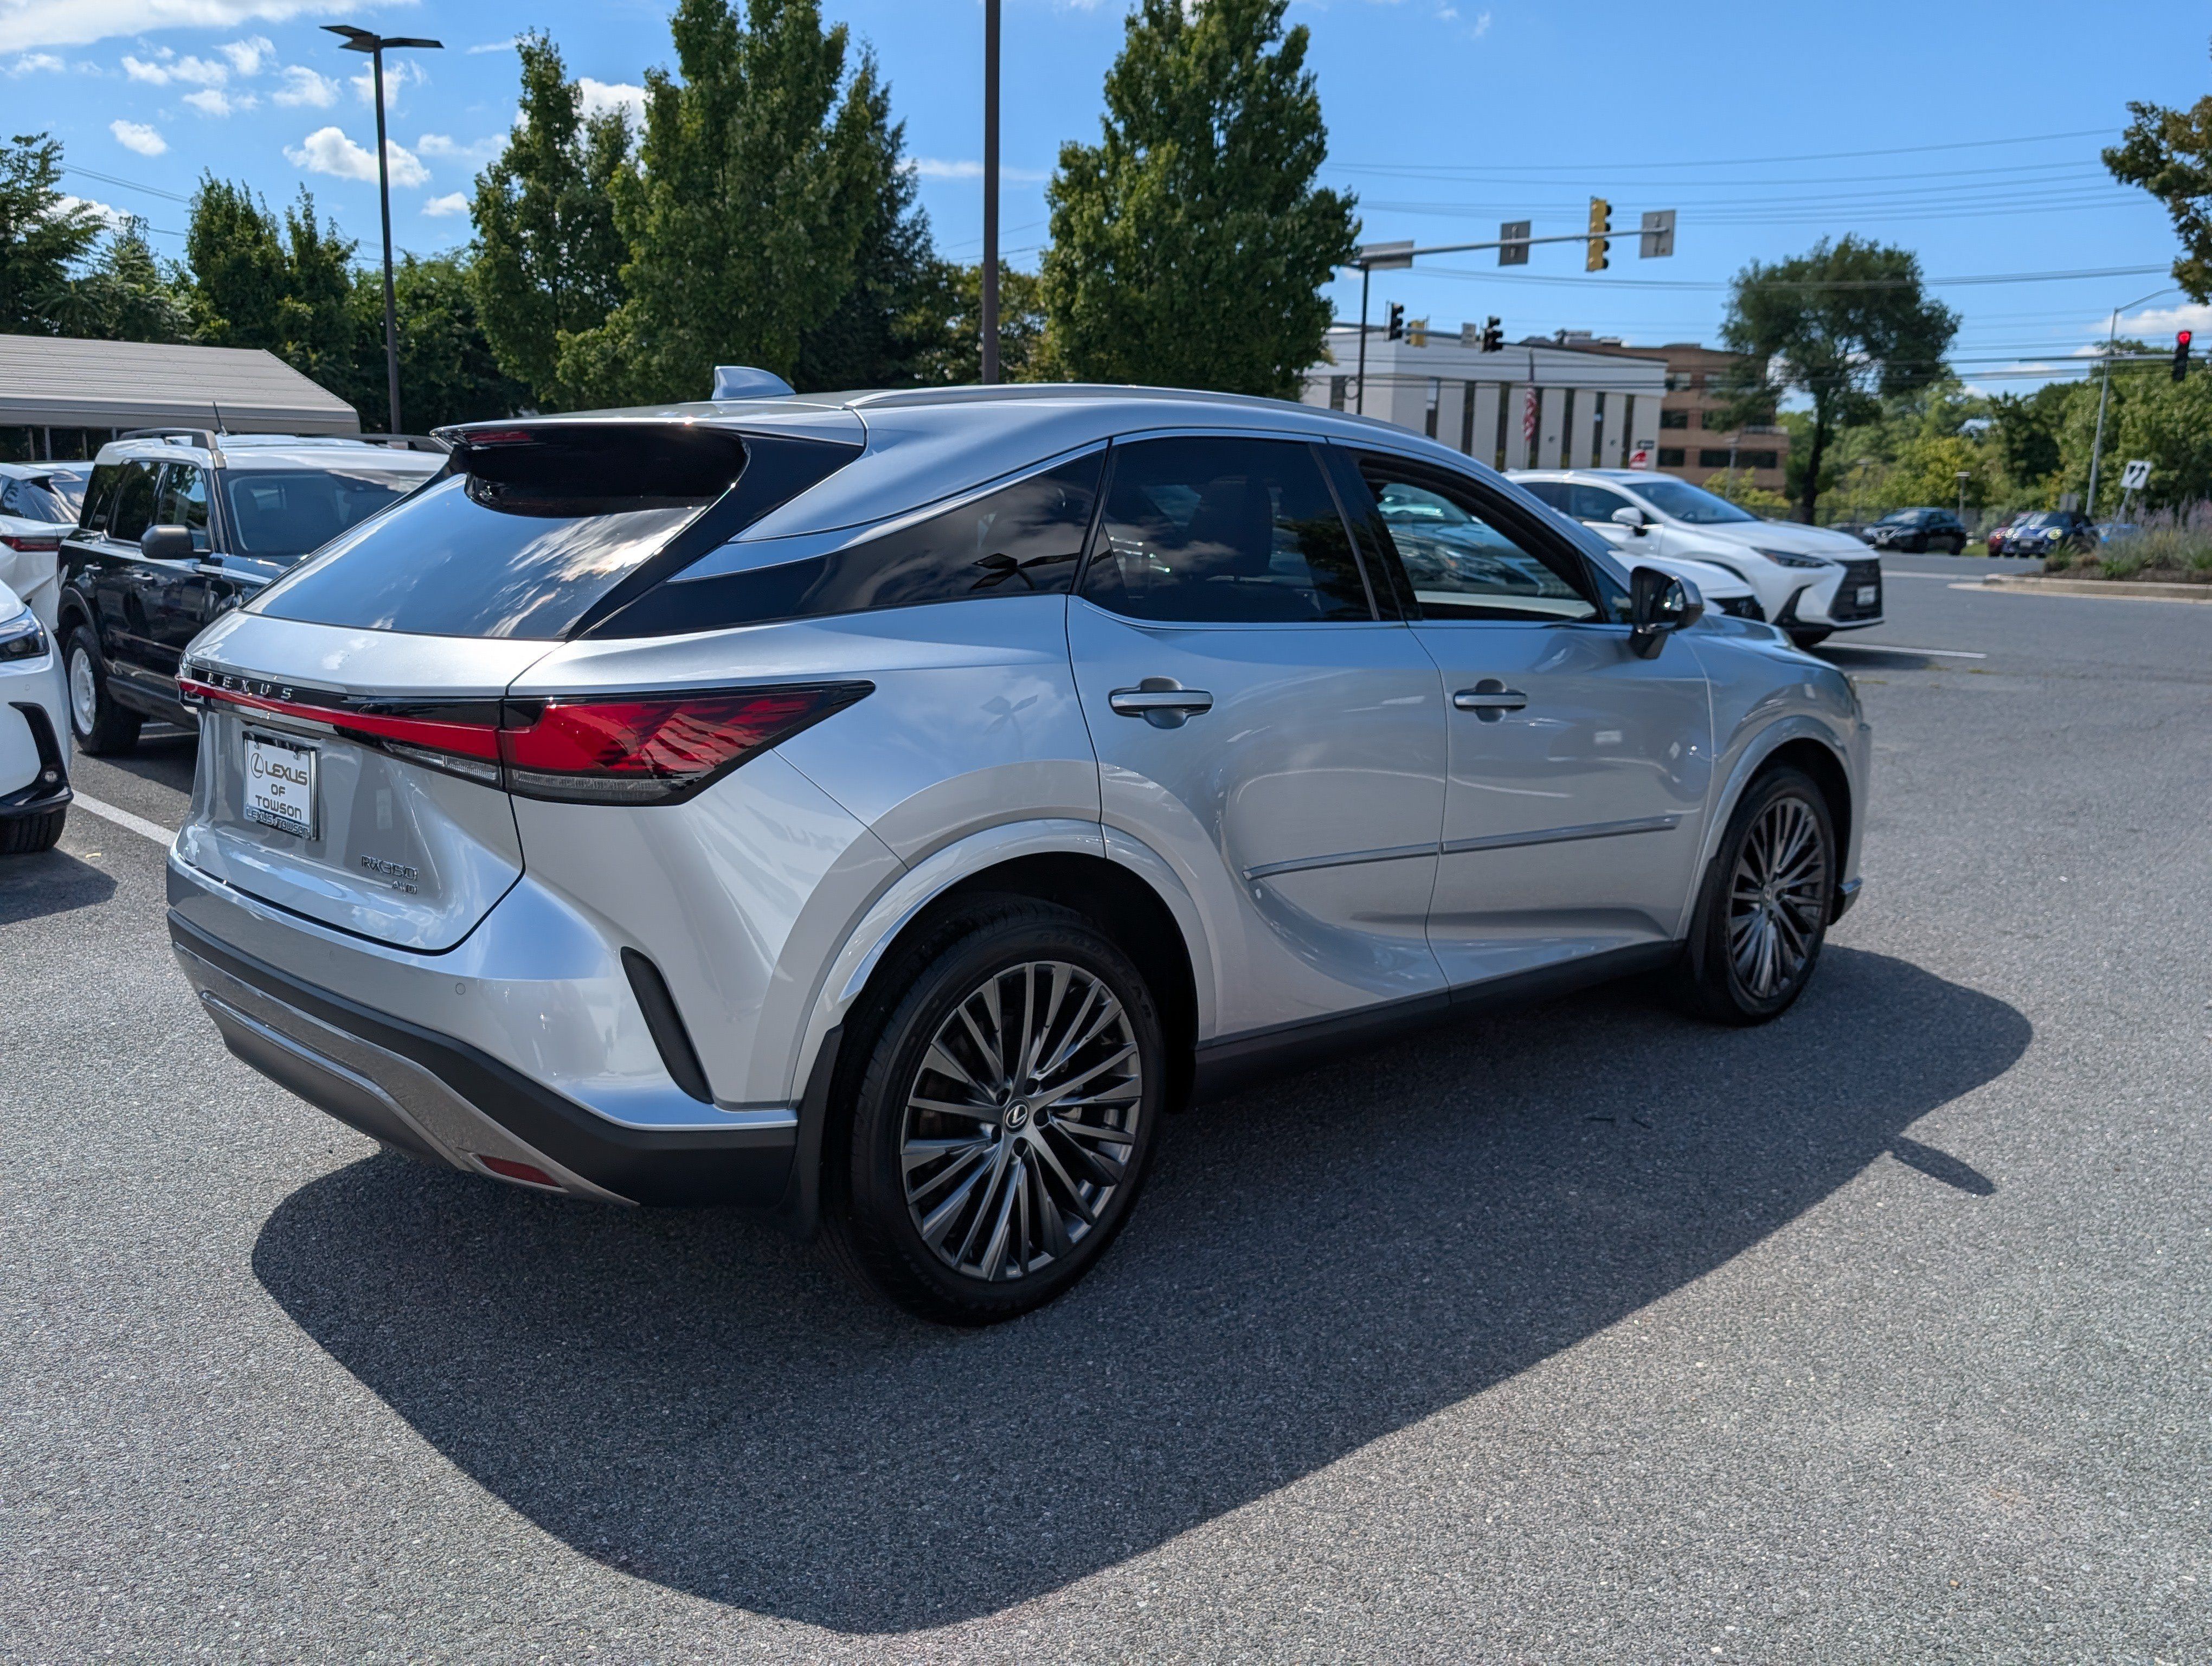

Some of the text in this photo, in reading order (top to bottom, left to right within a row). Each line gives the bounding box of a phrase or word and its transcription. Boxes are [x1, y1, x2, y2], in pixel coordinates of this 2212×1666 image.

[208, 672, 293, 700] LEXUS
[265, 760, 307, 786] LEXUS
[271, 784, 286, 797] OF
[255, 794, 302, 820] TOWSON
[246, 808, 273, 825] LEXUS
[277, 817, 310, 838] TOWSON
[392, 881, 417, 894] AWD
